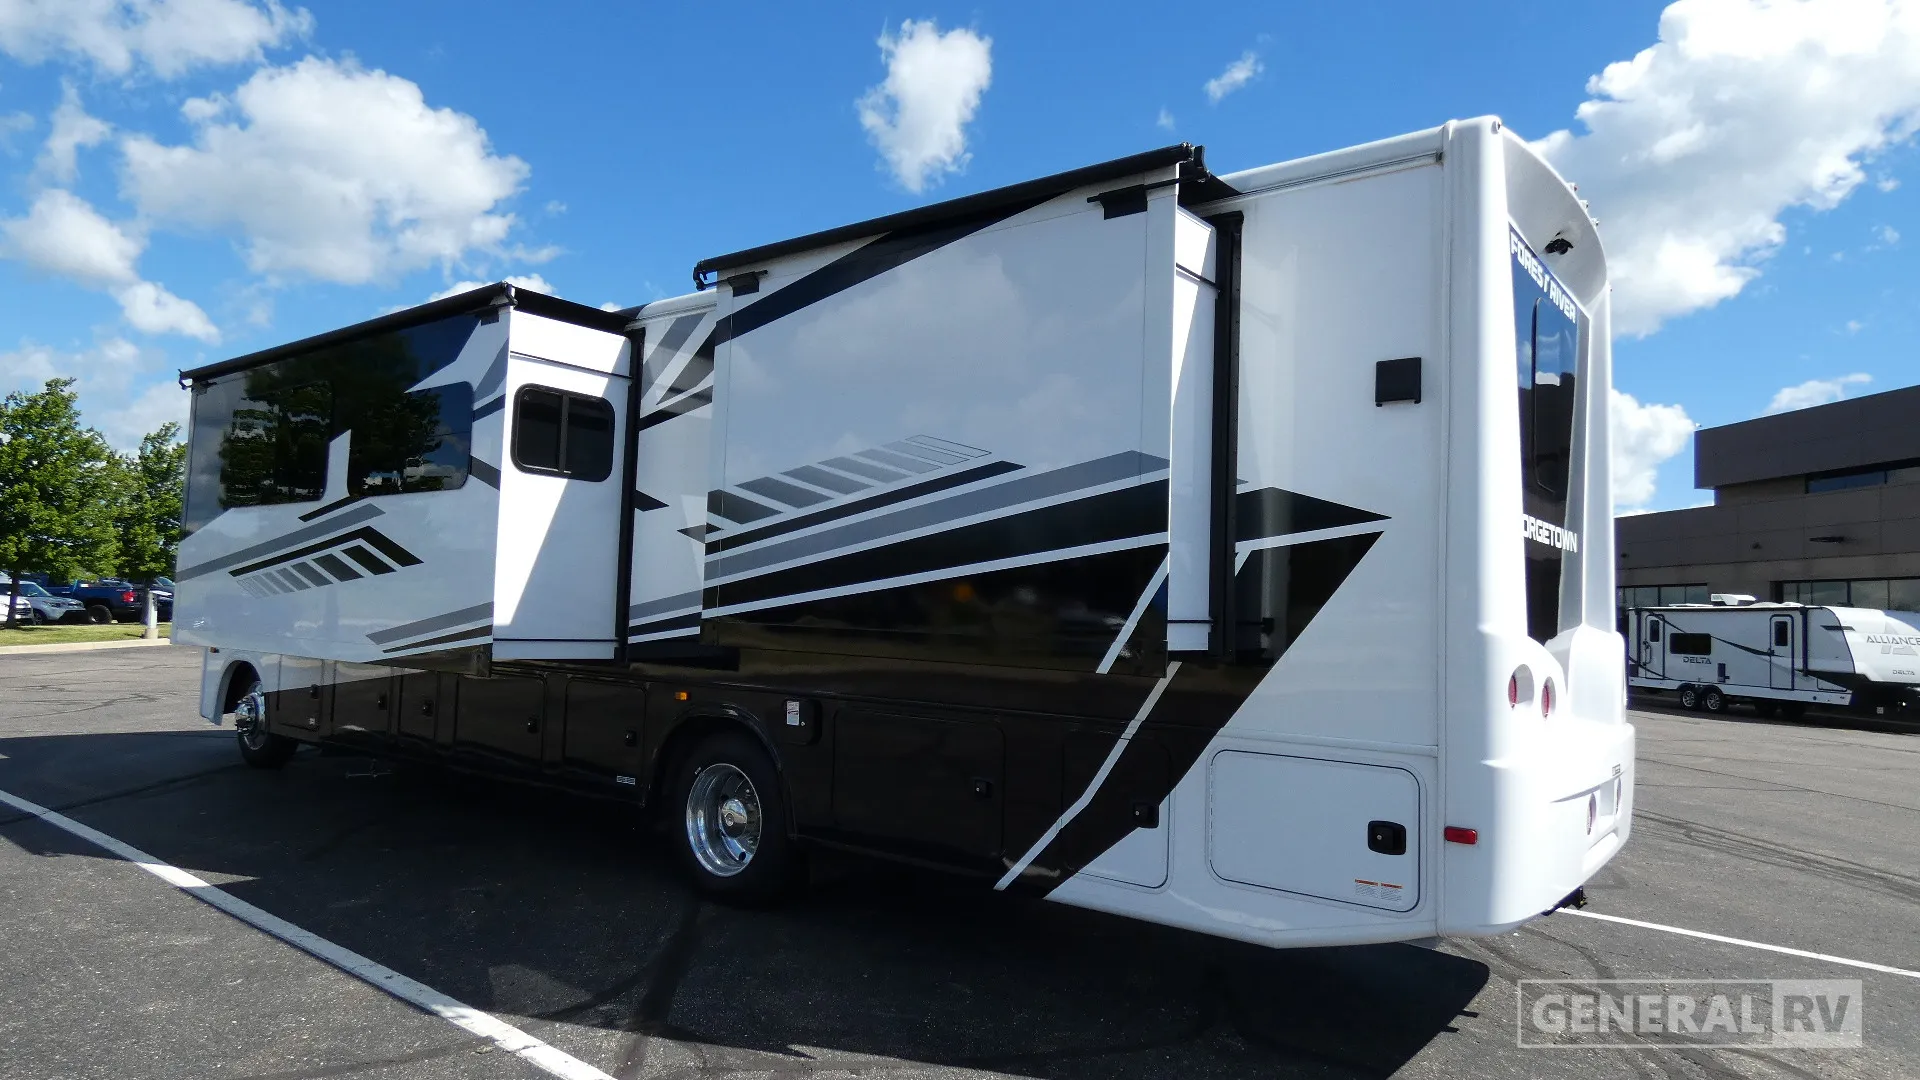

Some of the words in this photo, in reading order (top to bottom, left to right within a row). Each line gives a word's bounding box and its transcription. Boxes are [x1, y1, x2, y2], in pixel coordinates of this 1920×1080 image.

[1510, 231, 1550, 293] FOREST
[1549, 279, 1576, 324] RIVER
[1521, 513, 1577, 553] ORGETOWN
[1866, 634, 1920, 646] ALLIANCE
[1682, 656, 1712, 665] DELTA
